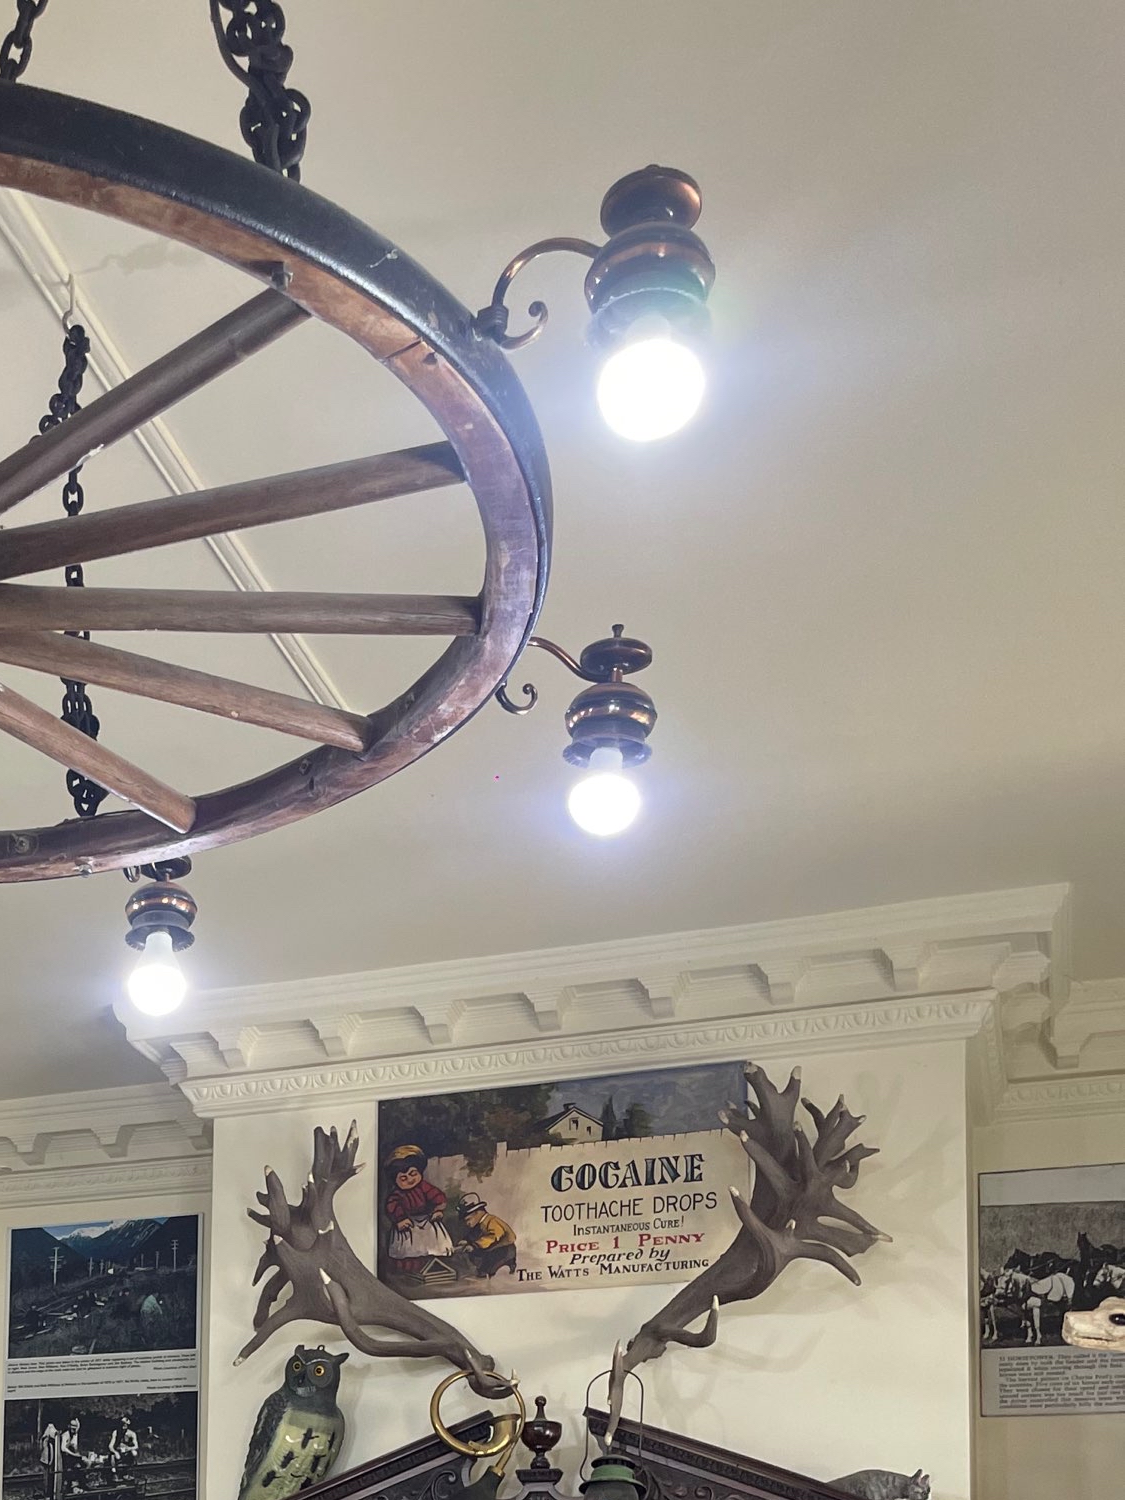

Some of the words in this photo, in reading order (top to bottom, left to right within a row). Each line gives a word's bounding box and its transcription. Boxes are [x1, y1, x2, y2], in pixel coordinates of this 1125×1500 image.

[551, 1154, 705, 1192] COCAINE
[540, 1198, 644, 1223] TOOTHACHE
[653, 1192, 718, 1214] DROPS
[653, 1216, 685, 1229] CURE!
[546, 1240, 600, 1254] PRICE
[613, 1236, 620, 1249] 1
[638, 1233, 705, 1247] PENNY
[569, 1249, 644, 1266] Prepared
[648, 1247, 671, 1262] by
[516, 1269, 542, 1282] THE
[547, 1265, 589, 1279] WATTS
[599, 1259, 709, 1275] MANUFACTURING
